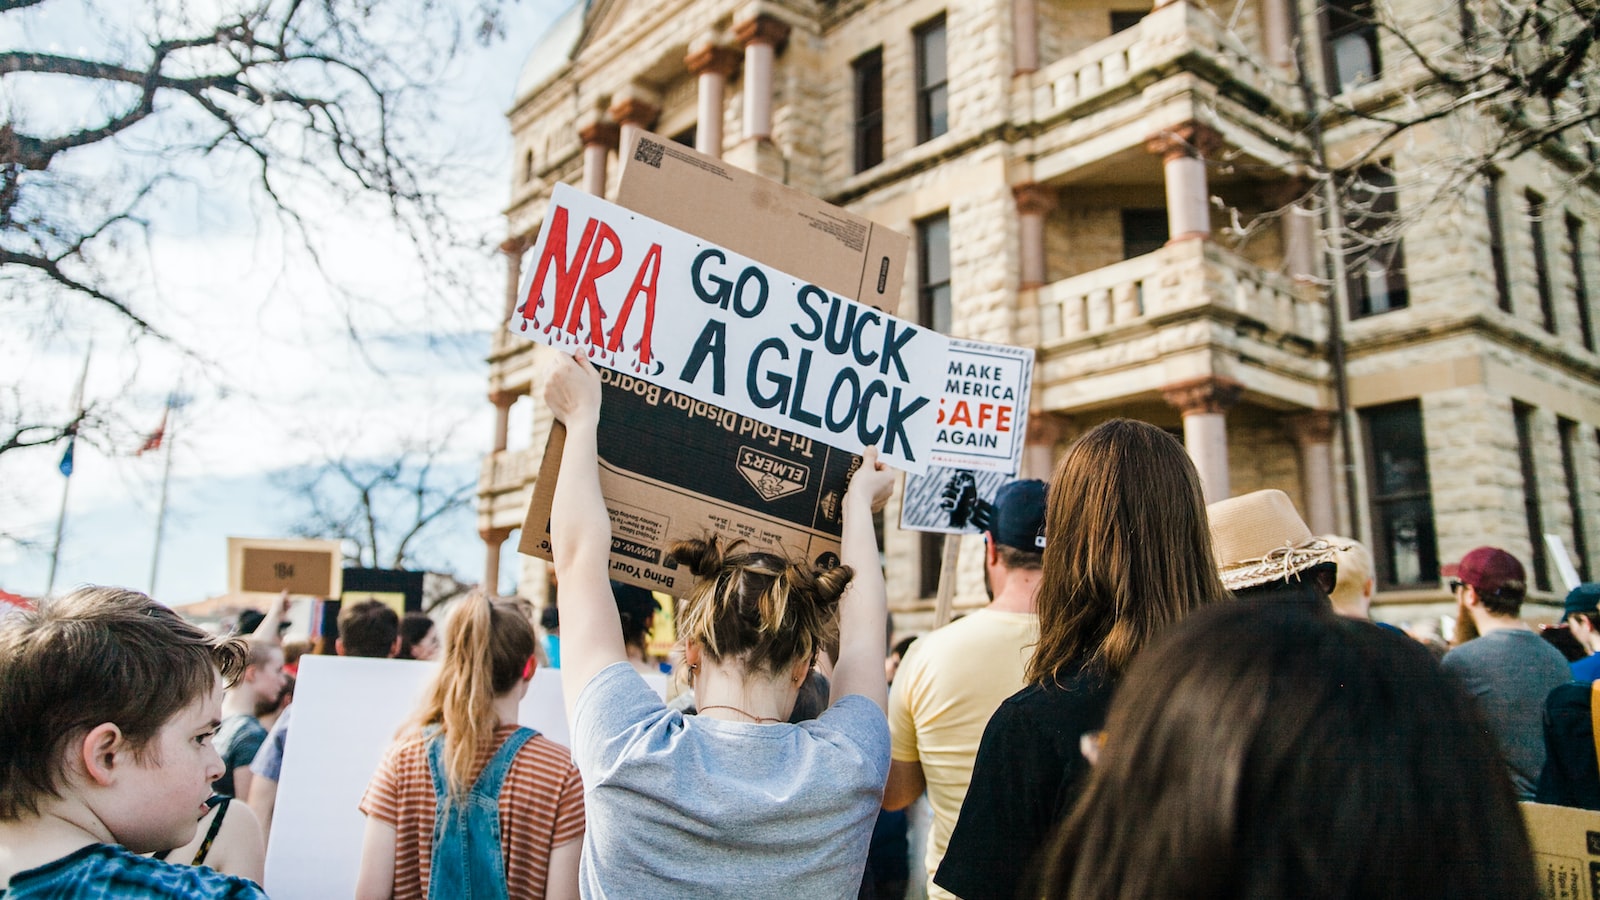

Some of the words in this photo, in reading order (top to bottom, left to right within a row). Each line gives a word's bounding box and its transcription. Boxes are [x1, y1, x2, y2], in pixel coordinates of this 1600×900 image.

[691, 248, 769, 319] GO
[790, 284, 917, 384] SUCK
[947, 361, 1002, 381] MAKE
[679, 318, 727, 396] A
[746, 337, 930, 462] GLOCK
[945, 379, 1014, 401] MERICA
[663, 390, 737, 432] Display
[738, 416, 814, 458] Tri-Fold
[936, 429, 998, 448] AGAIN
[743, 451, 805, 482] ELMER'S
[612, 561, 641, 579] Your
[643, 568, 675, 588] Bring
